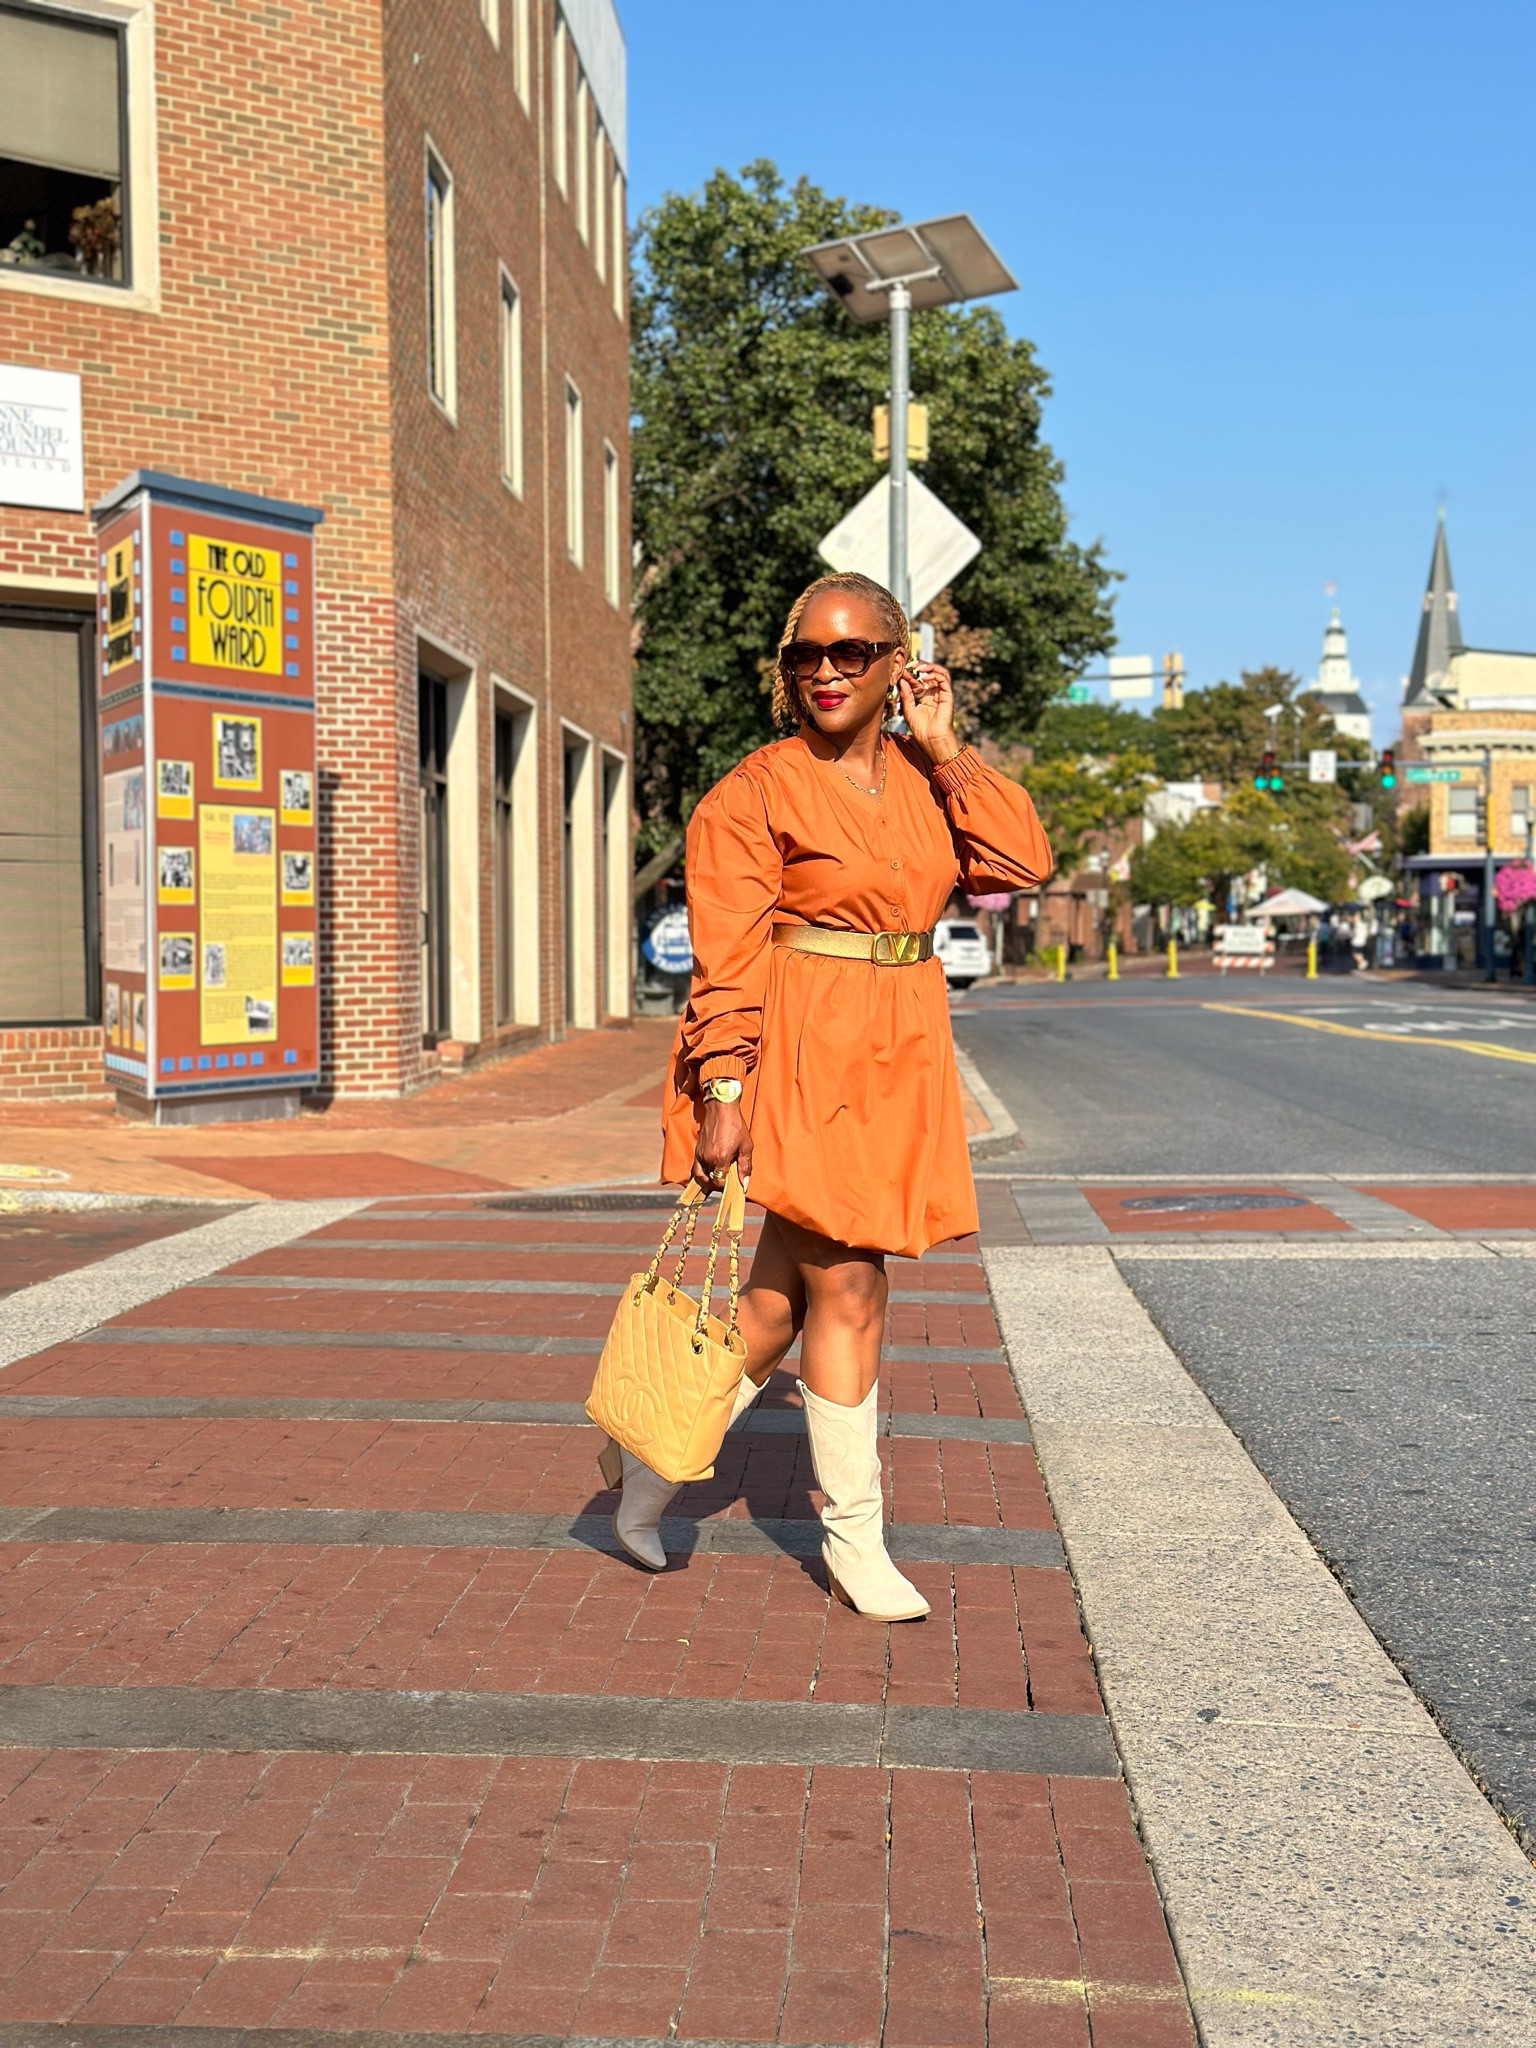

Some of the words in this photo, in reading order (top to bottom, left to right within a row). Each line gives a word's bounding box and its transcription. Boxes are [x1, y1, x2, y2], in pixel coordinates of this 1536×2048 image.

[0, 405, 33, 425] NNE
[0, 421, 69, 445] RUNDEL
[0, 437, 59, 457] OUNTY
[0, 455, 71, 473] YLAND
[207, 544, 228, 573] THE
[233, 550, 266, 579] OLD
[198, 576, 275, 628] FOURTH
[209, 621, 266, 668] WARD
